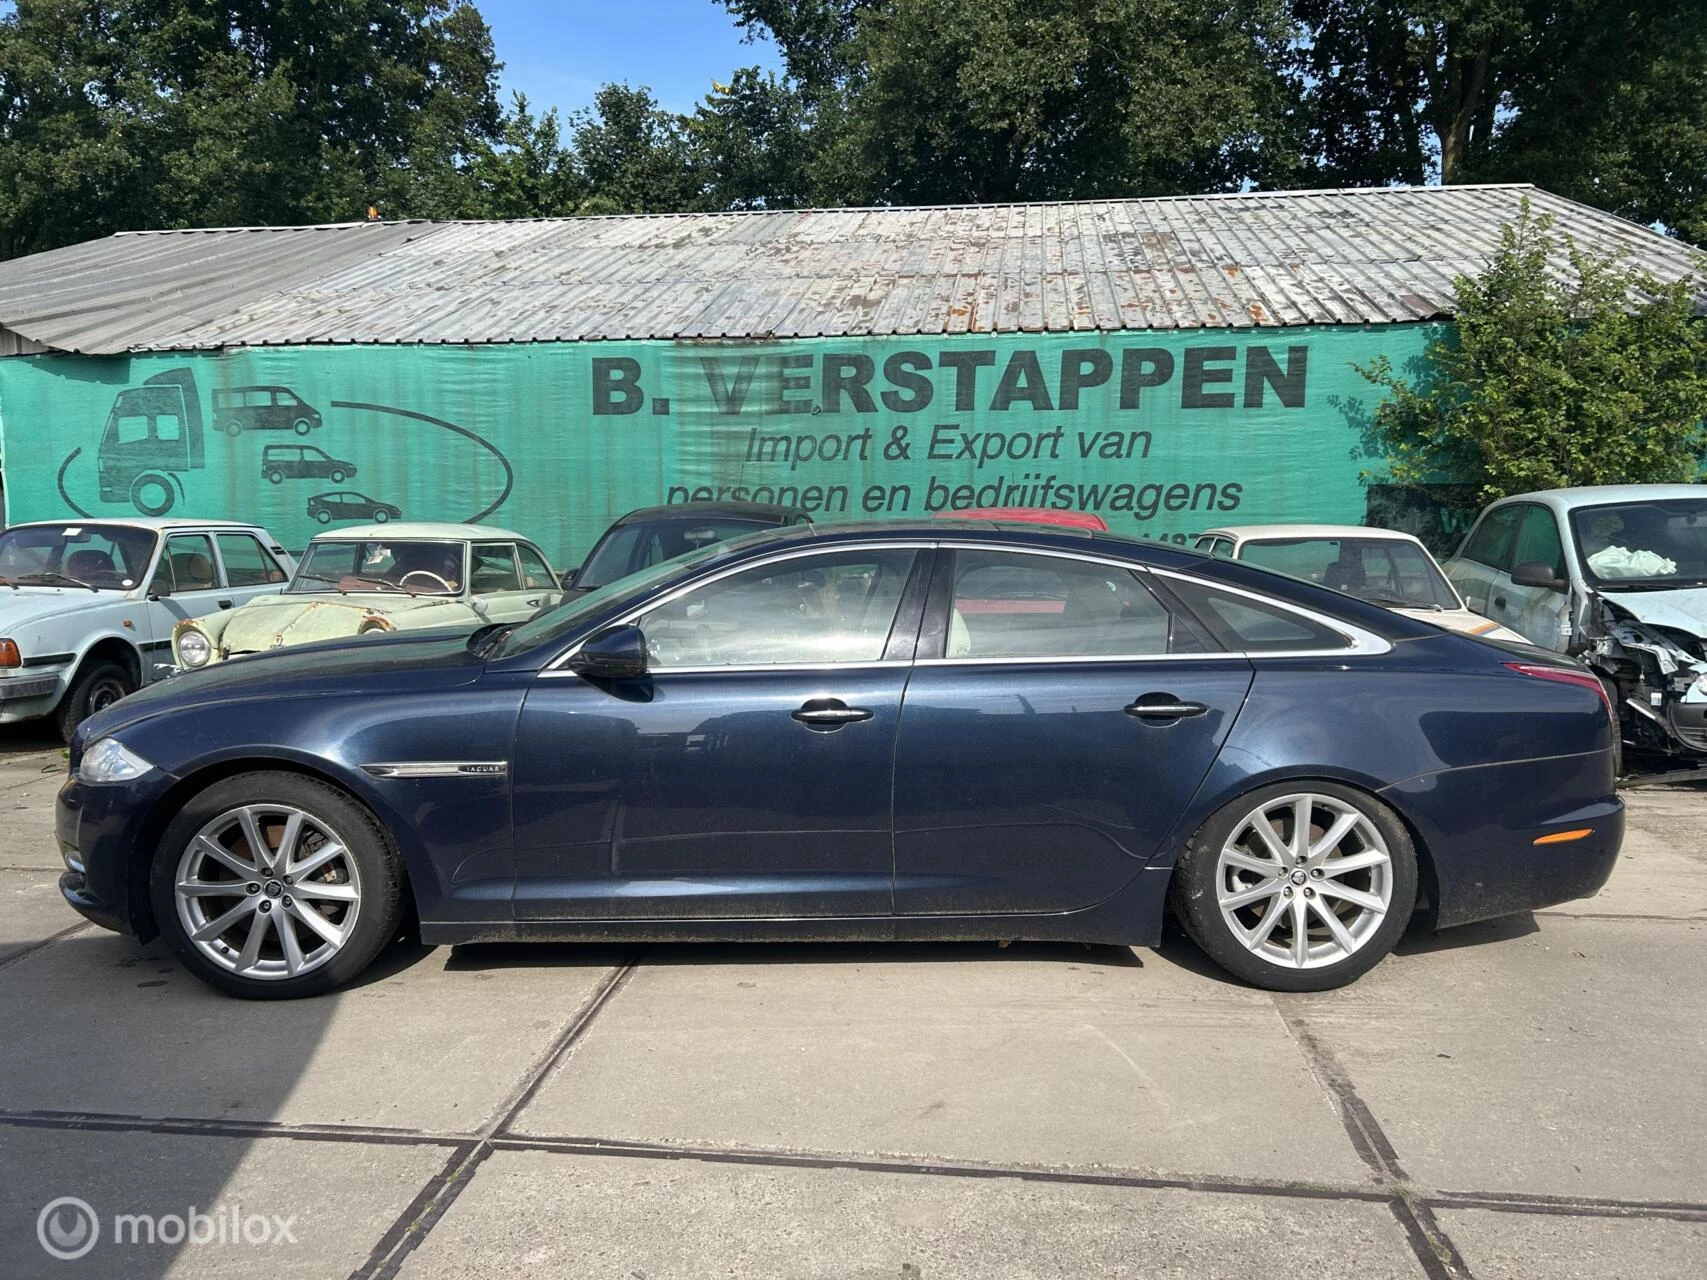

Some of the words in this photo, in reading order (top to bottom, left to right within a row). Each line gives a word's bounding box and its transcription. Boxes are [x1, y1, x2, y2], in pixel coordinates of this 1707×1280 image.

[593, 357, 670, 415] B.
[700, 345, 1309, 415] VERSTAPPEN
[745, 427, 872, 470] Import
[883, 426, 911, 460] &
[927, 424, 1063, 469] Export
[1077, 432, 1152, 459] van
[862, 485, 911, 512] en
